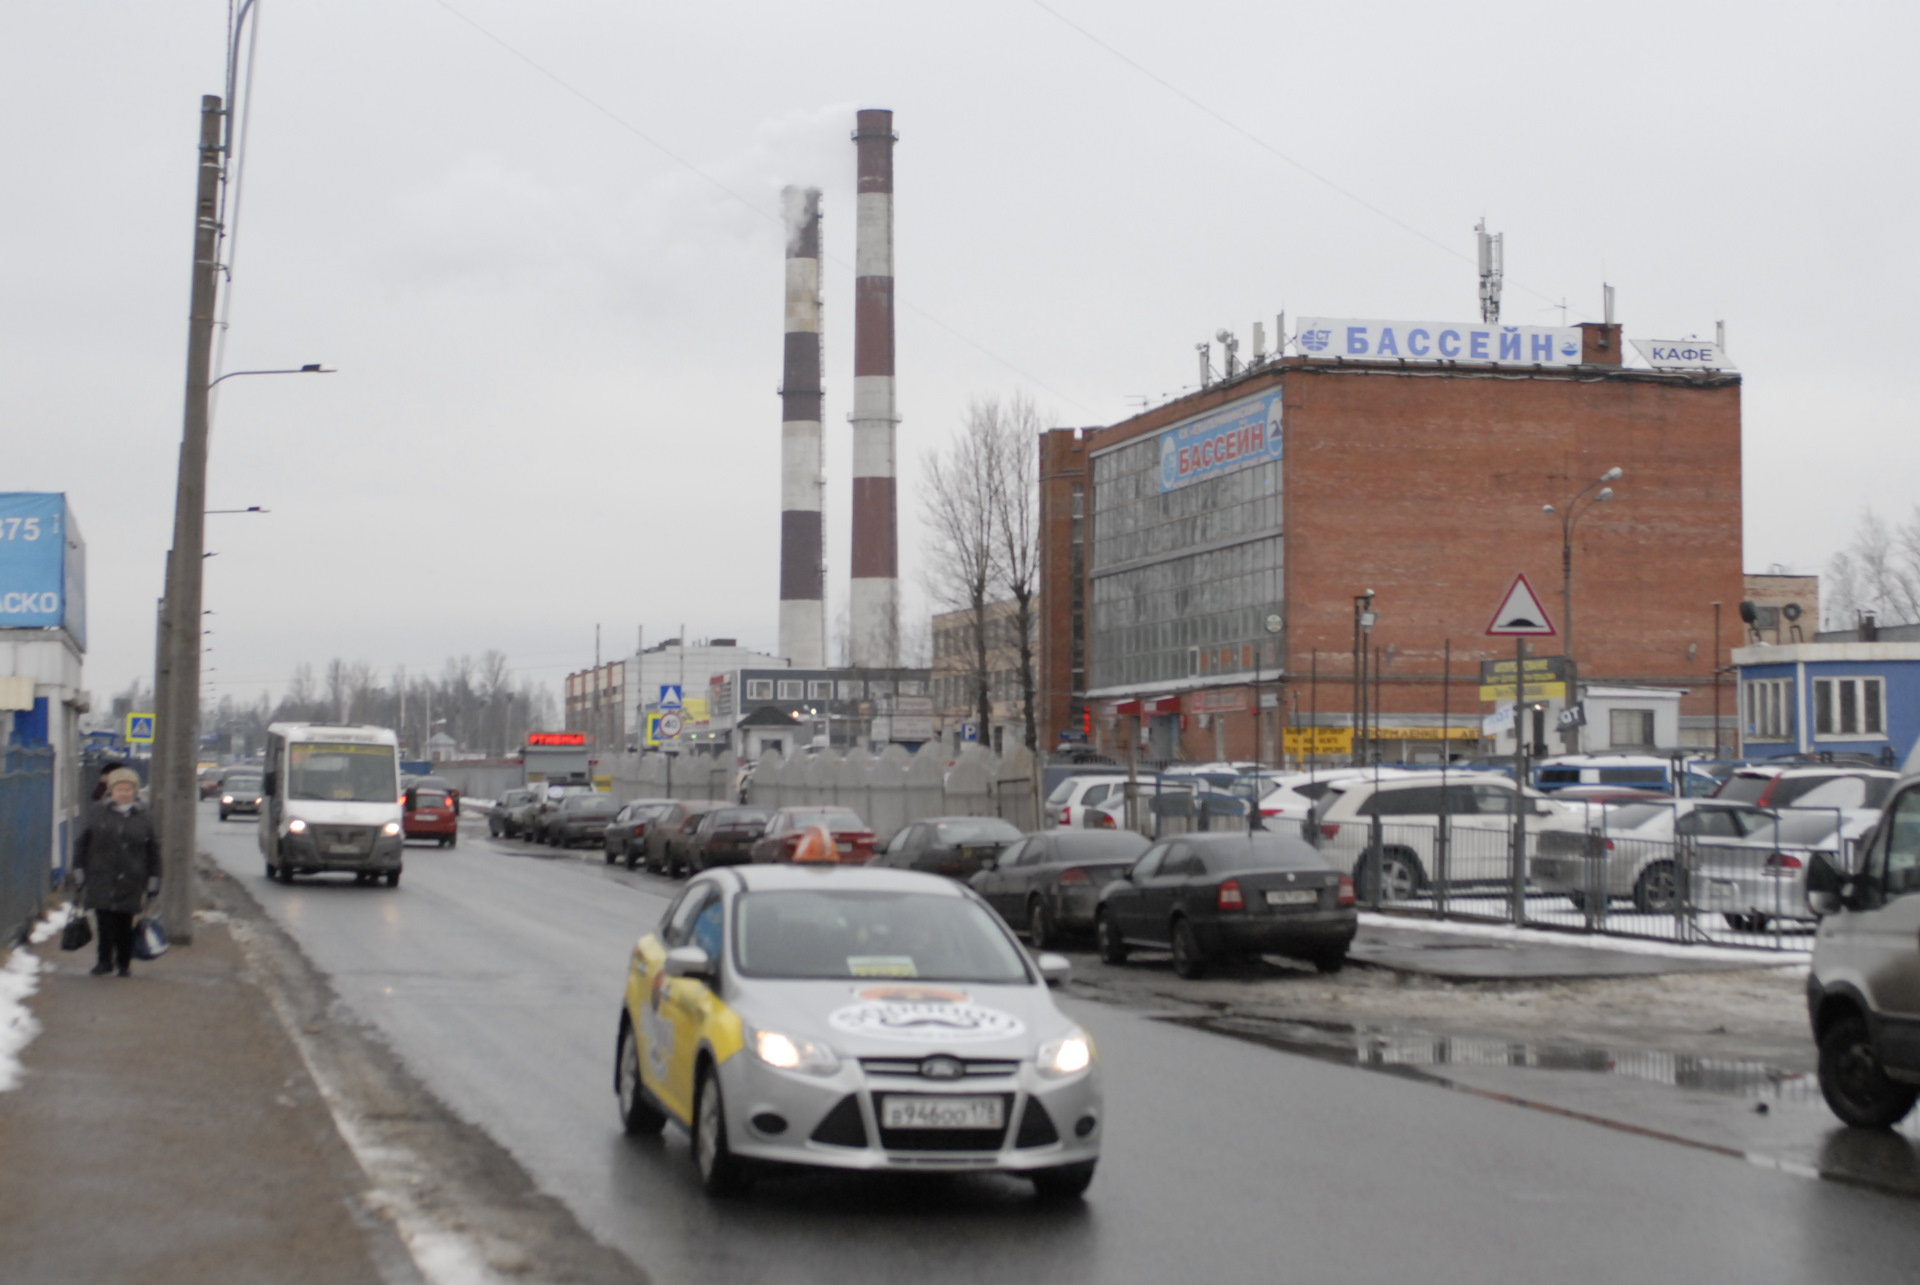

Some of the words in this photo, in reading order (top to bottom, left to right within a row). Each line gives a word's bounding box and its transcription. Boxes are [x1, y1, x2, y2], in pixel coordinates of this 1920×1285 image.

[1346, 326, 1555, 361] БАССЕЙН
[1651, 346, 1713, 361] КАФЕ
[1178, 421, 1265, 476] БАССЕЙН
[0, 592, 58, 614] СКО
[664, 719, 678, 728] 40
[891, 1102, 967, 1125] В946ОО
